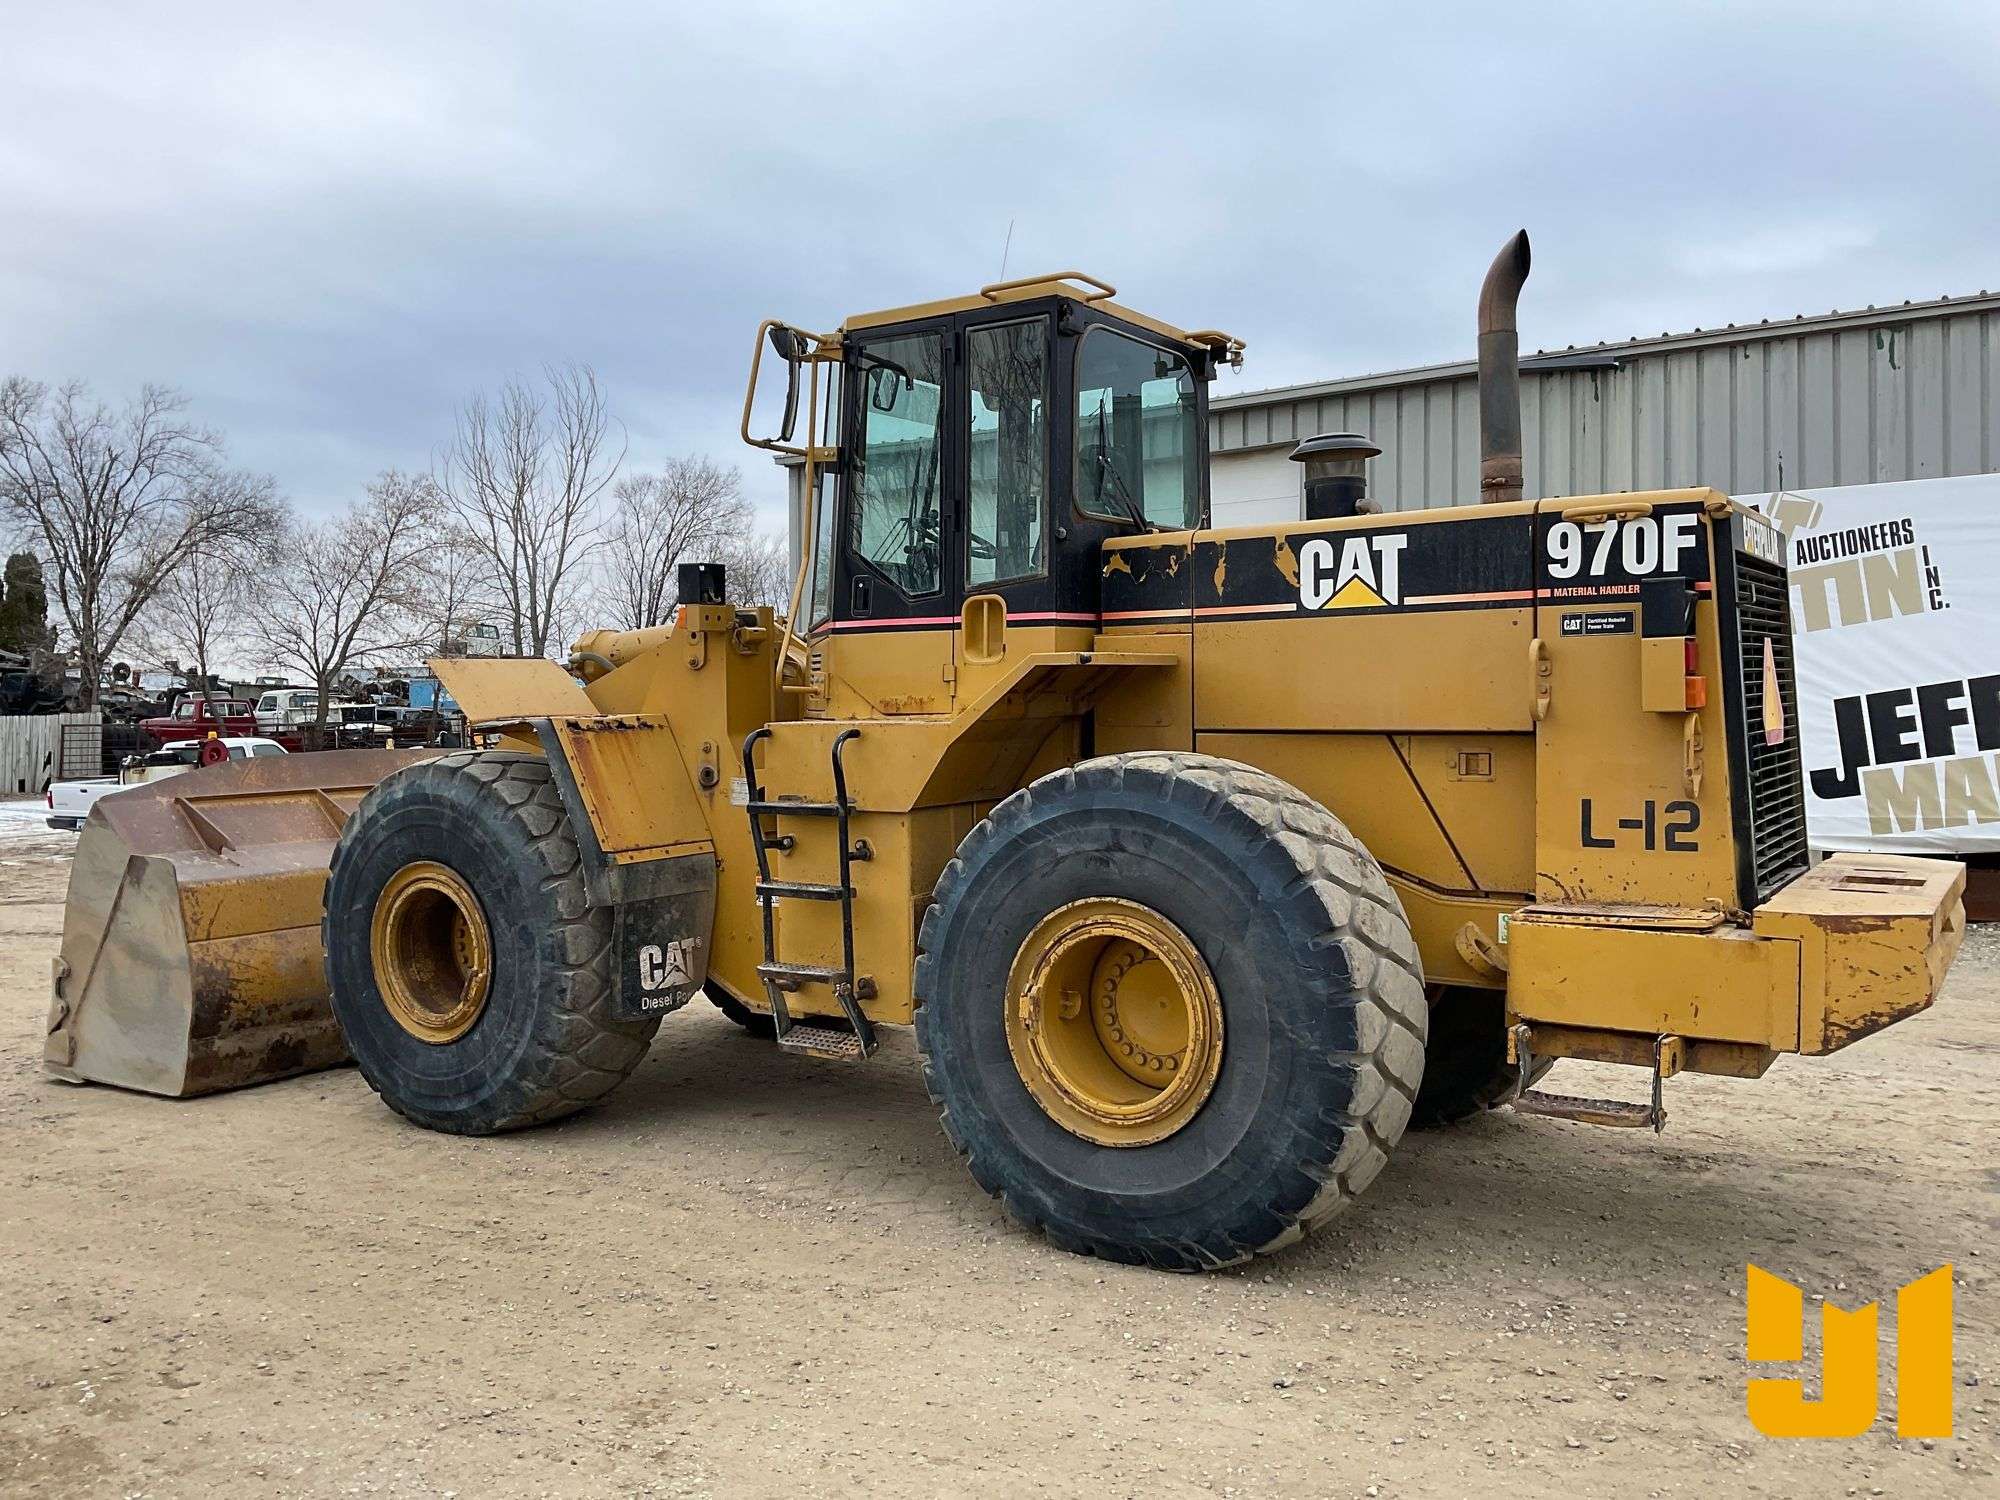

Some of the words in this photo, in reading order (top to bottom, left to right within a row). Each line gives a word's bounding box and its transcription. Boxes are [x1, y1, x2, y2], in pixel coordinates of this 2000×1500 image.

[1547, 513, 1698, 579] 970F
[1796, 518, 1915, 566] AUCTIONEERS
[1300, 533, 1408, 610] CAT
[1553, 586, 1598, 597] MATERIAL
[1599, 584, 1640, 595] HANDLER
[1563, 619, 1582, 631] CAT
[1862, 753, 2000, 836] MA
[1581, 798, 1701, 852] L-12
[640, 938, 696, 991] CAT
[641, 993, 673, 1010] Diesel
